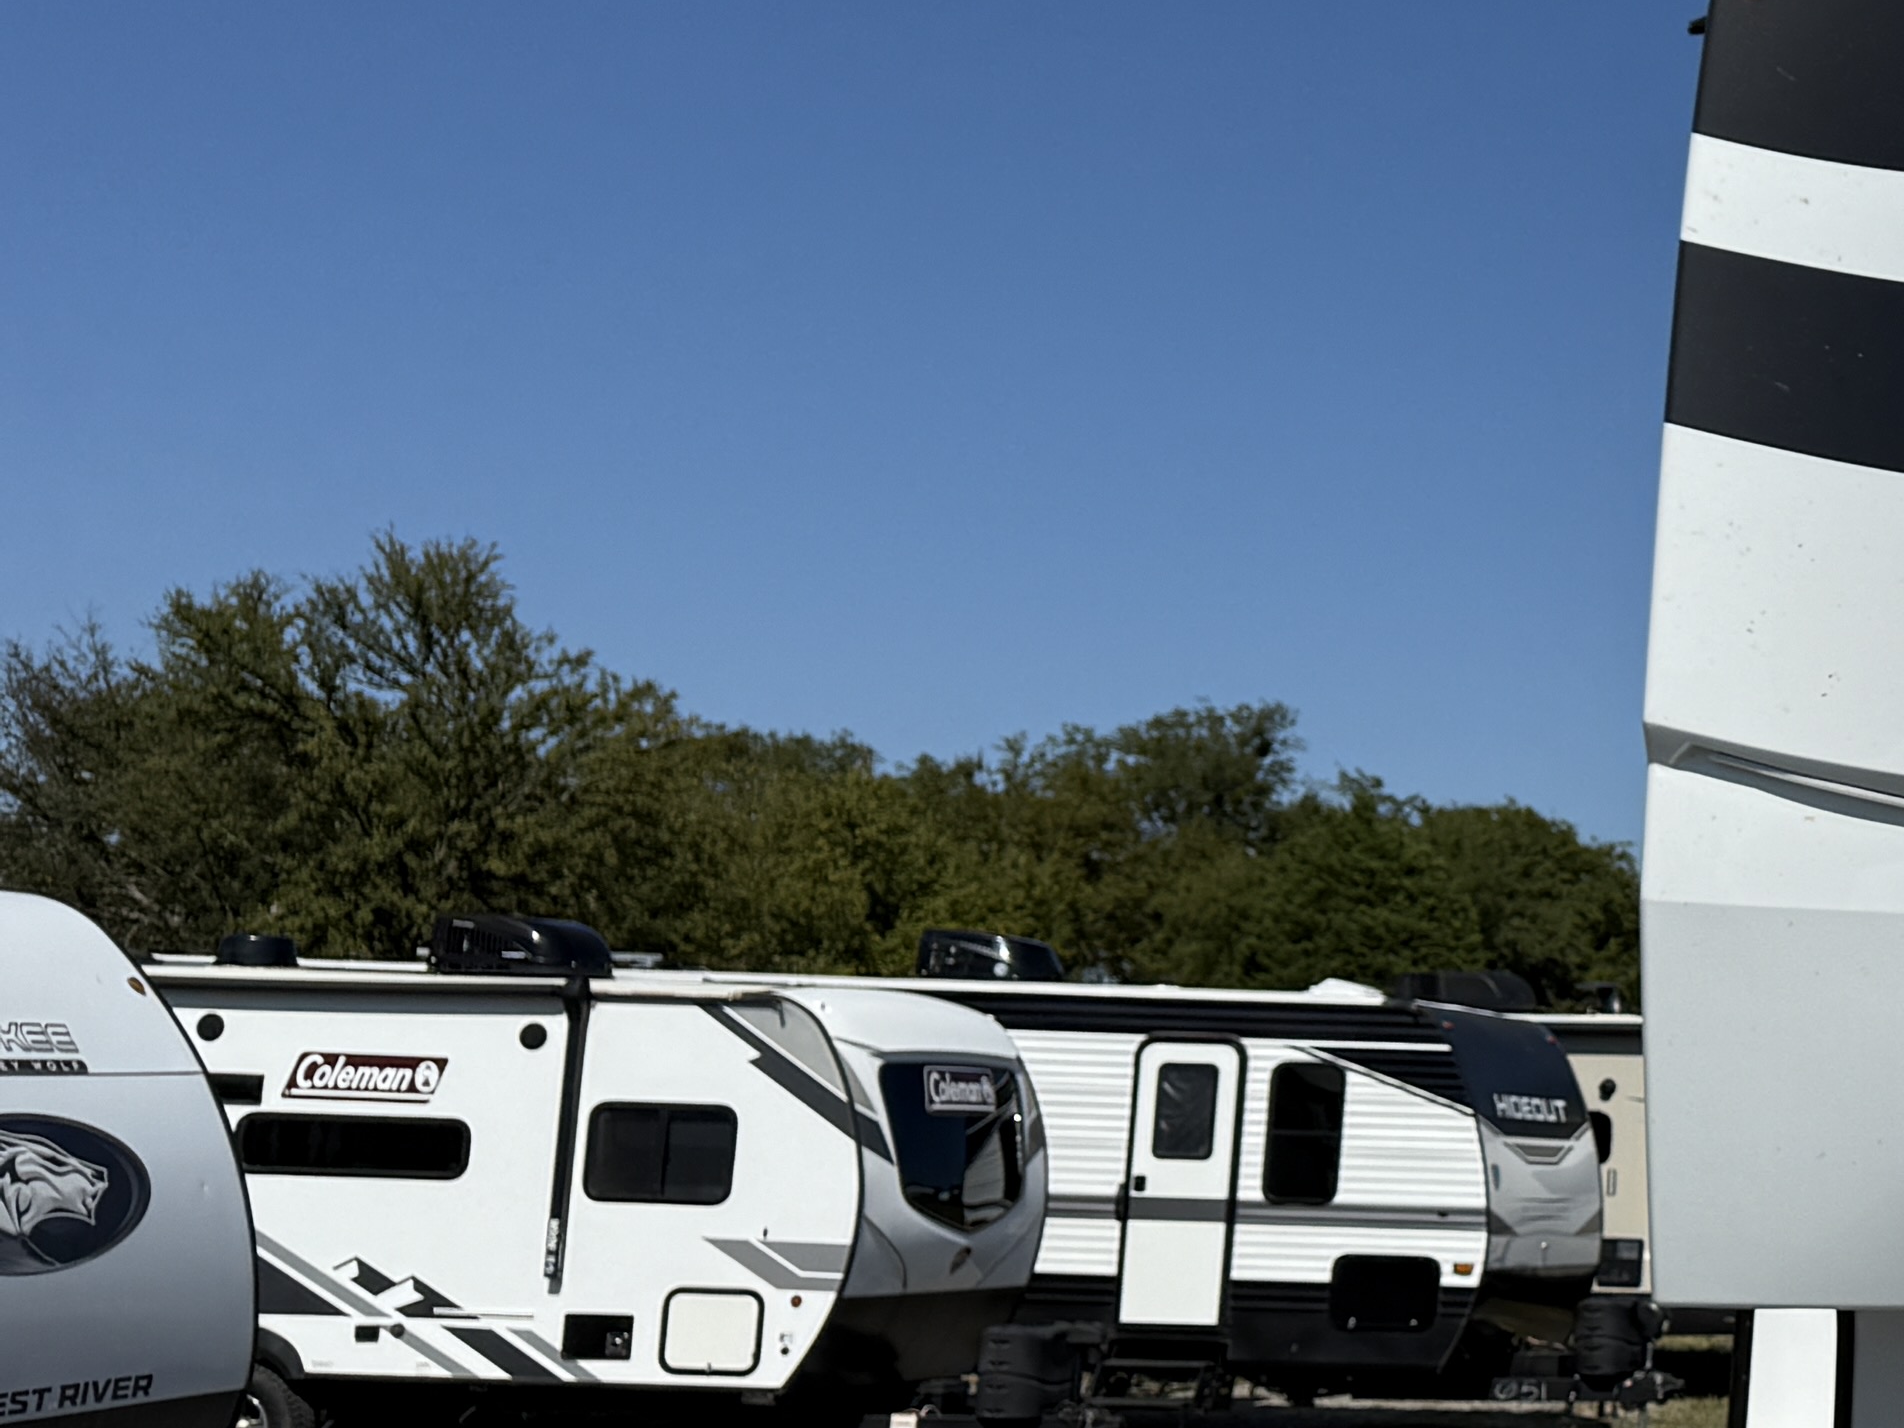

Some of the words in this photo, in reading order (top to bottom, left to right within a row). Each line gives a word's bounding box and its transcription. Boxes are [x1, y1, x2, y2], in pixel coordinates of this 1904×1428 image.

[296, 1054, 413, 1091] Coleman
[929, 1071, 983, 1102] Coleman
[1493, 1092, 1566, 1123] HIDEOUT
[58, 1374, 153, 1408] RIVER
